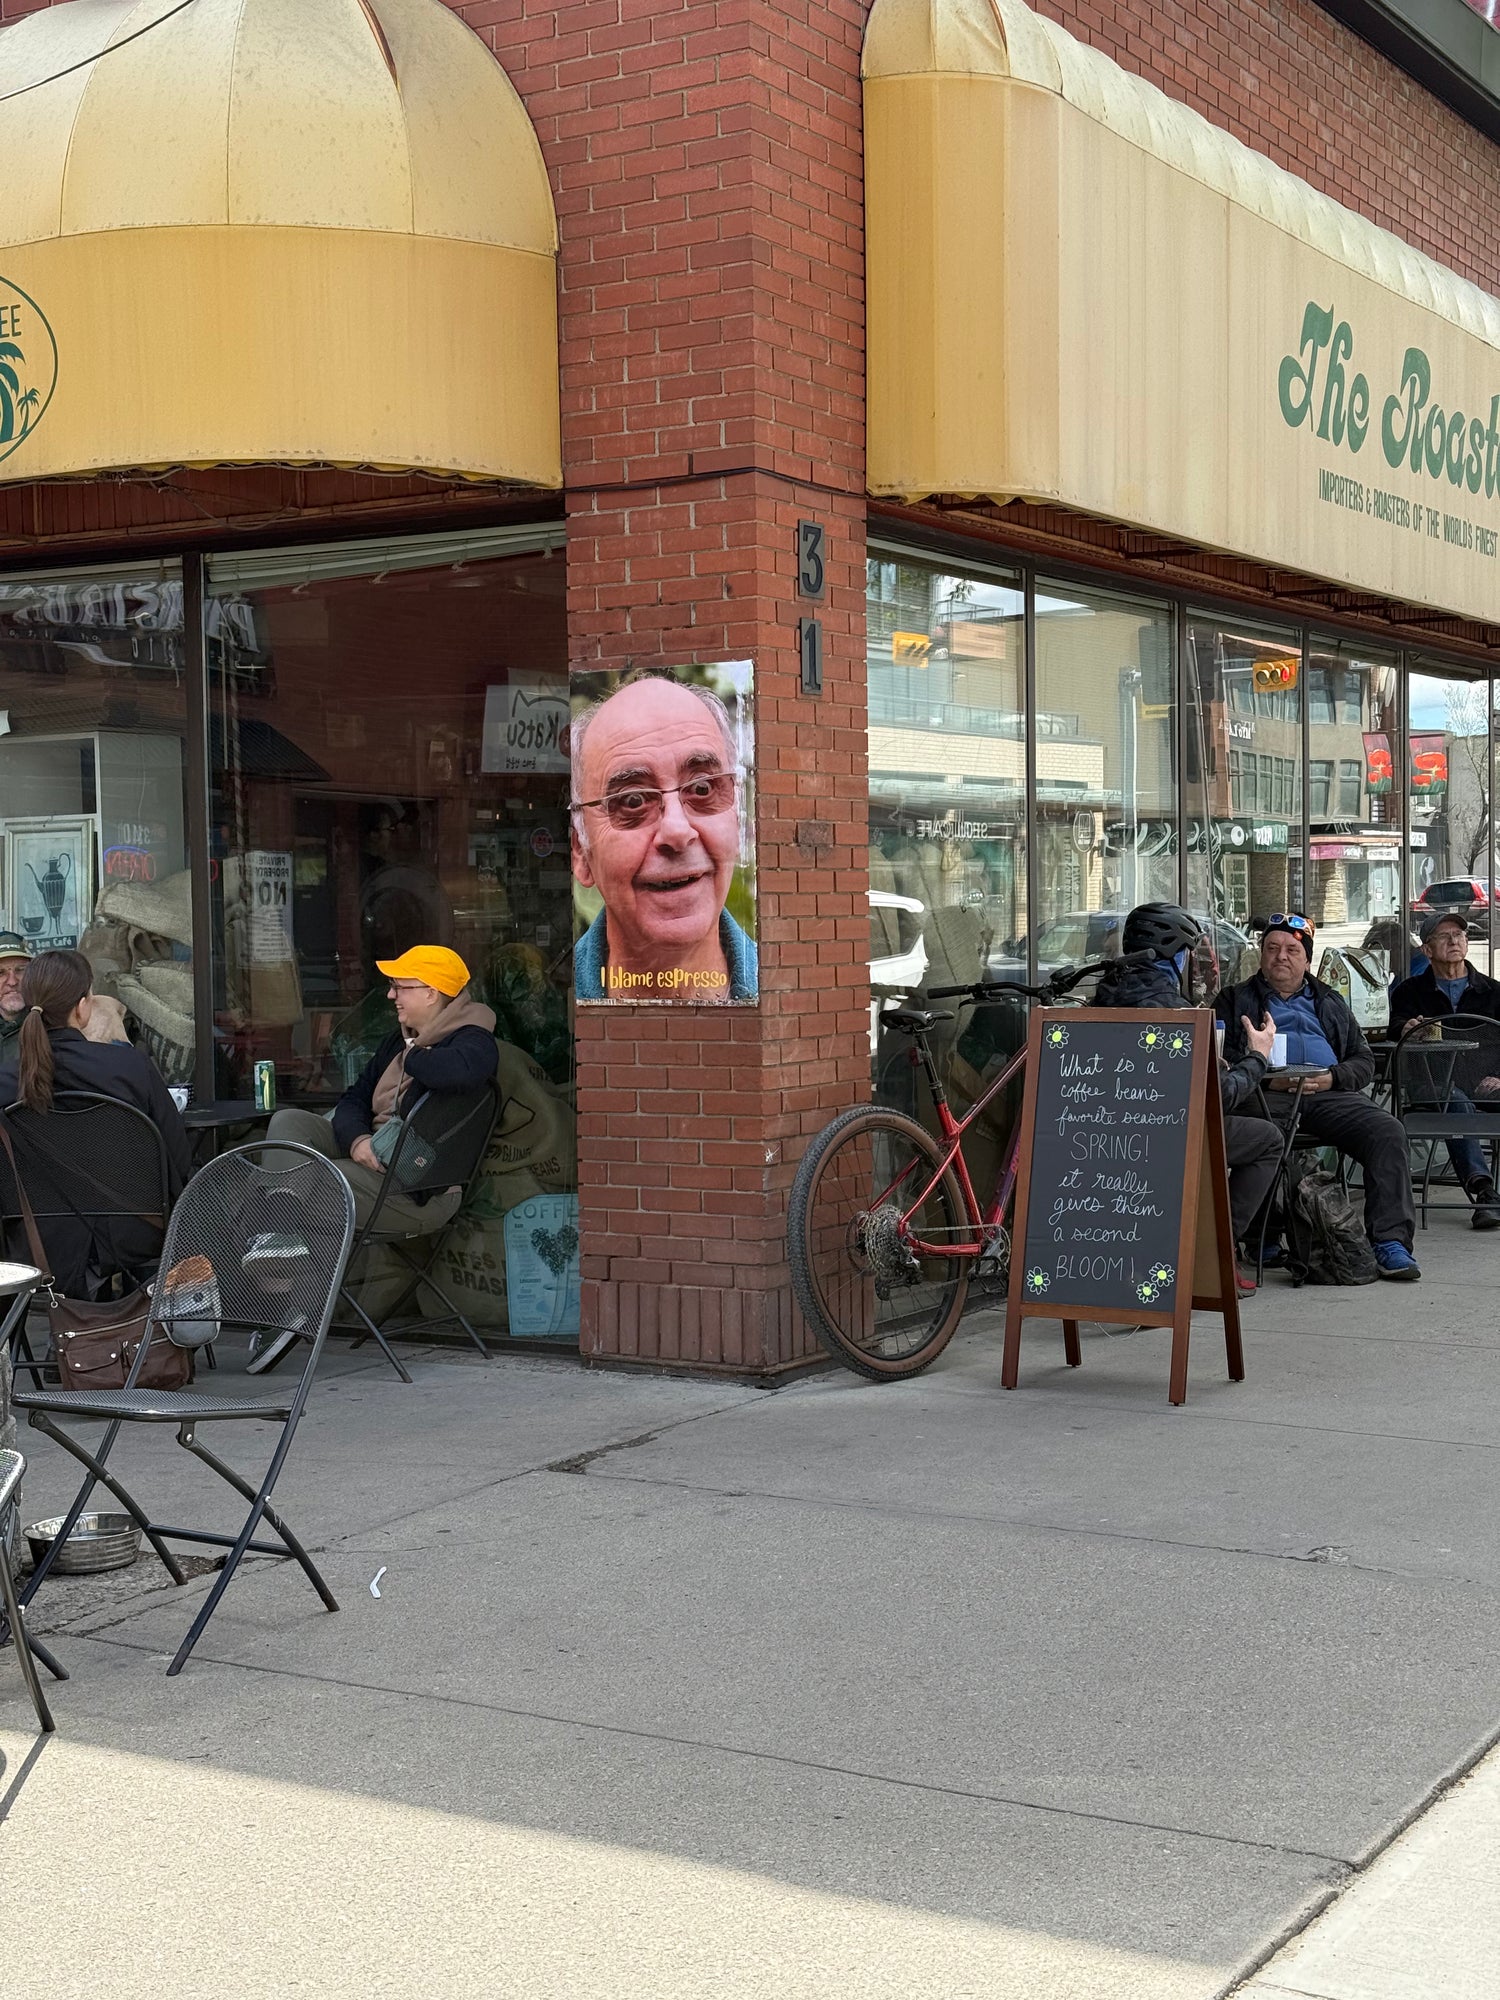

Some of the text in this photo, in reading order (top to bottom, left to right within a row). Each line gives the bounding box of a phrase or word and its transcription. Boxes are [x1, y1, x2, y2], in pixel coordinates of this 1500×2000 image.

[1278, 301, 1500, 500] The Roast
[1318, 468, 1499, 559] IMPORTERS & ROASTERS OF THE WORLD'S FINEST
[600, 965, 728, 989] I blame espresso
[1059, 1053, 1160, 1078] What is a
[1060, 1082, 1106, 1104] coffee
[1055, 1105, 1188, 1137] favorite season?
[1070, 1131, 1150, 1163] SPRING!
[1058, 1168, 1154, 1206] it really
[1048, 1194, 1164, 1226] gives them
[1053, 1221, 1142, 1243] a second
[1055, 1254, 1136, 1284] BLOOM!
